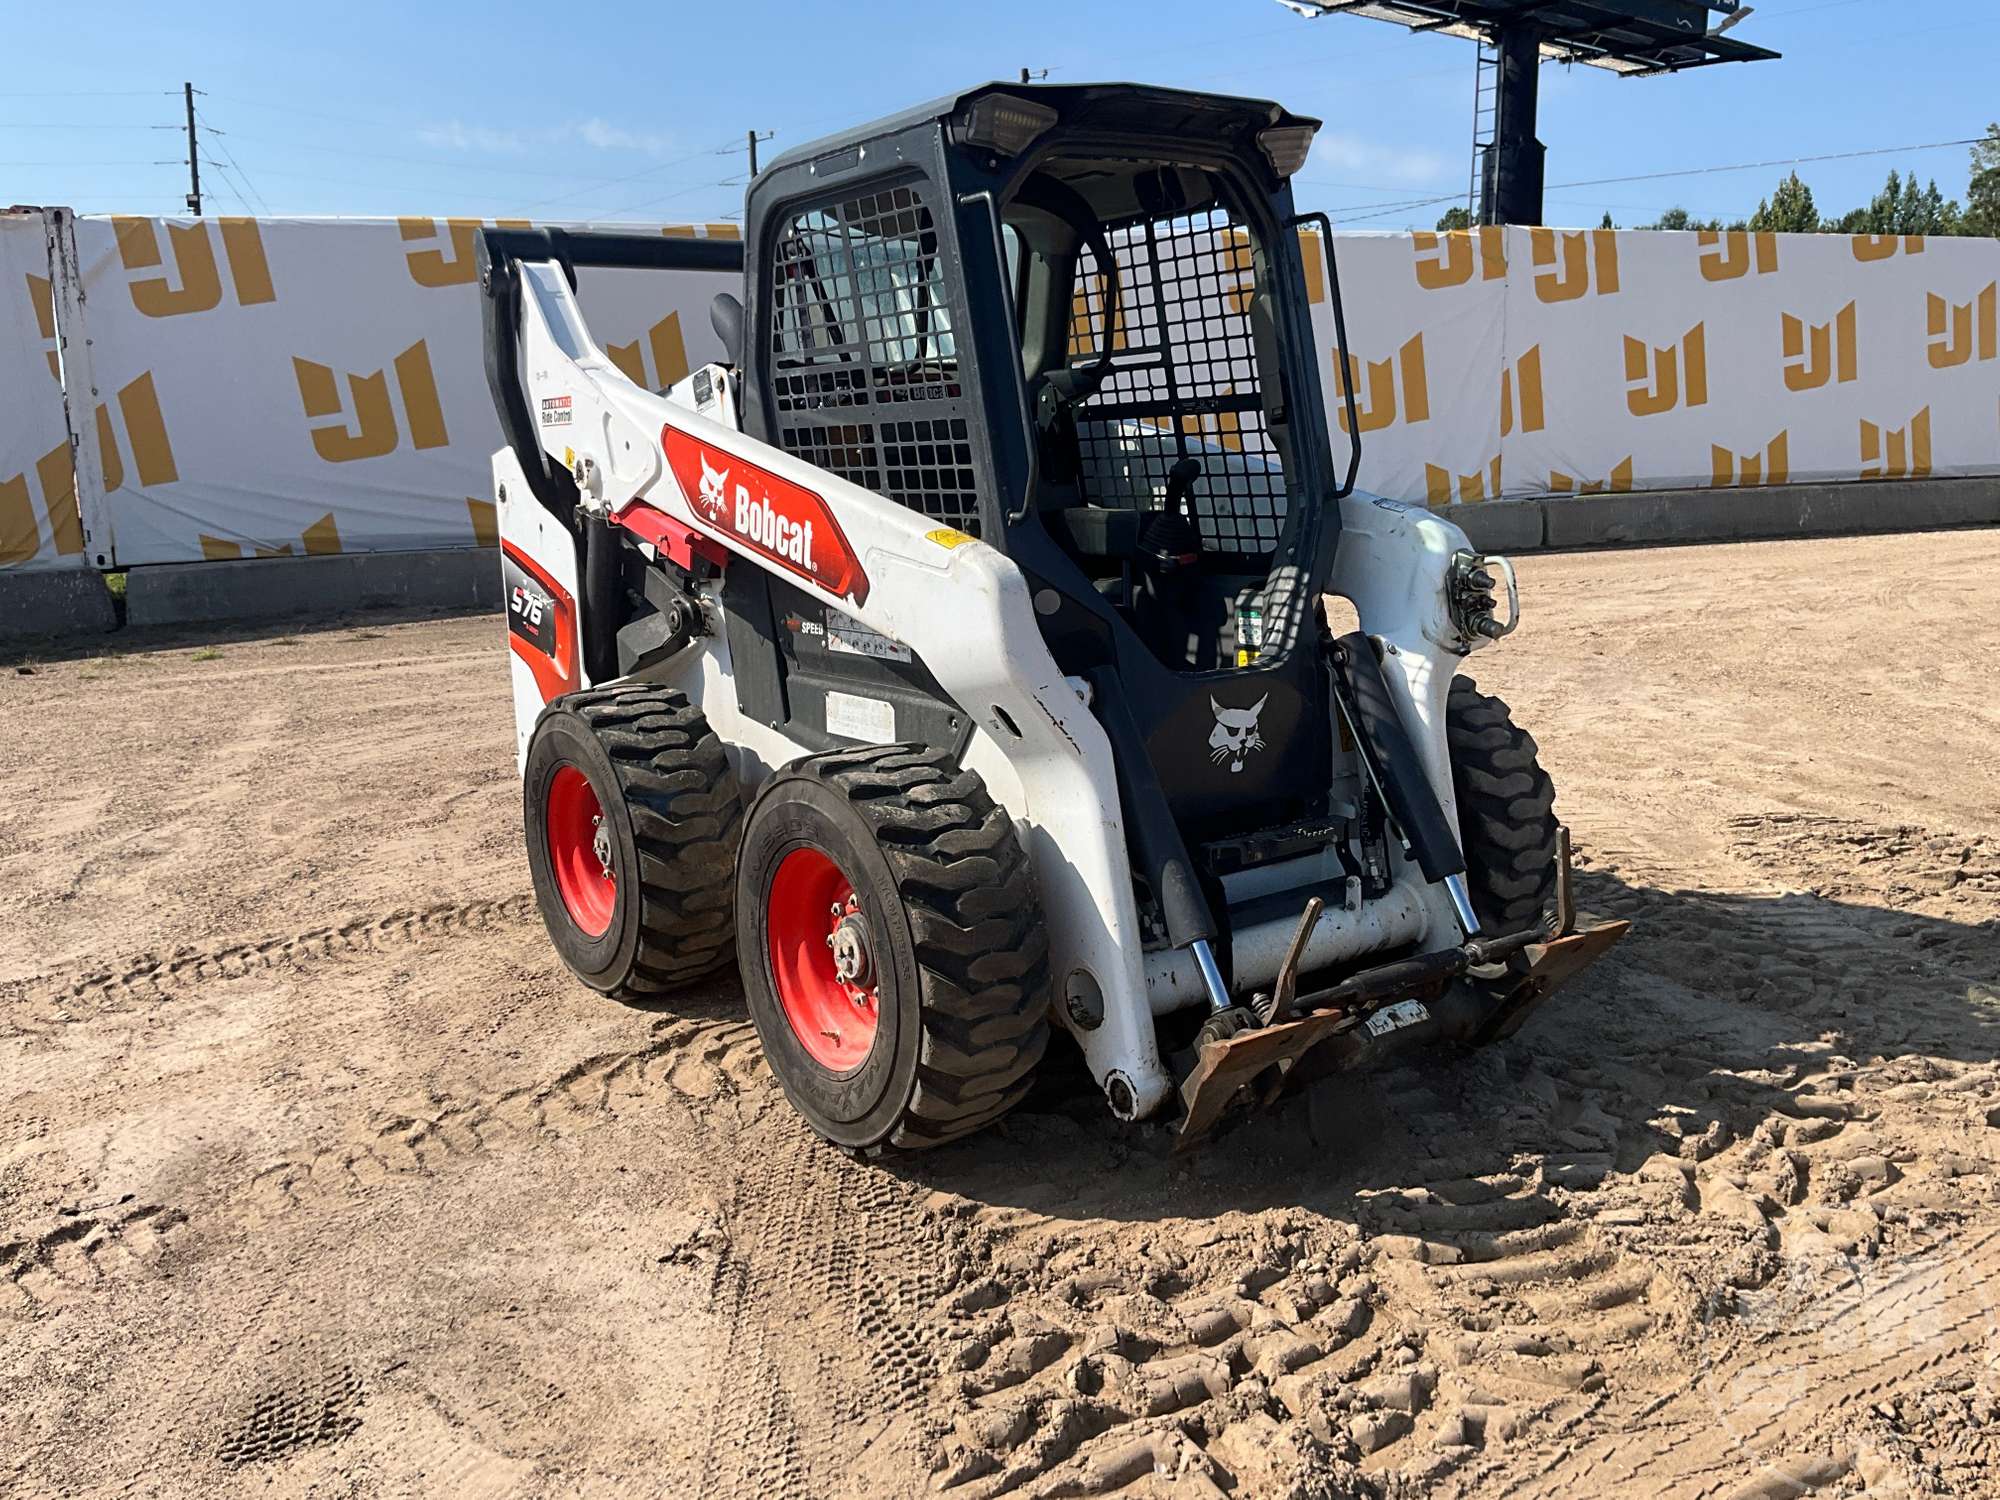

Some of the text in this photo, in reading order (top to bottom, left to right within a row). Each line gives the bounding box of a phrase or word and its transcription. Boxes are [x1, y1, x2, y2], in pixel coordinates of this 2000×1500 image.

[542, 397, 572, 409] AUTOMATIC
[541, 409, 572, 424] Ride Control
[735, 483, 813, 570] Bobcat
[511, 586, 543, 626] S76
[801, 621, 824, 636] SPEED
